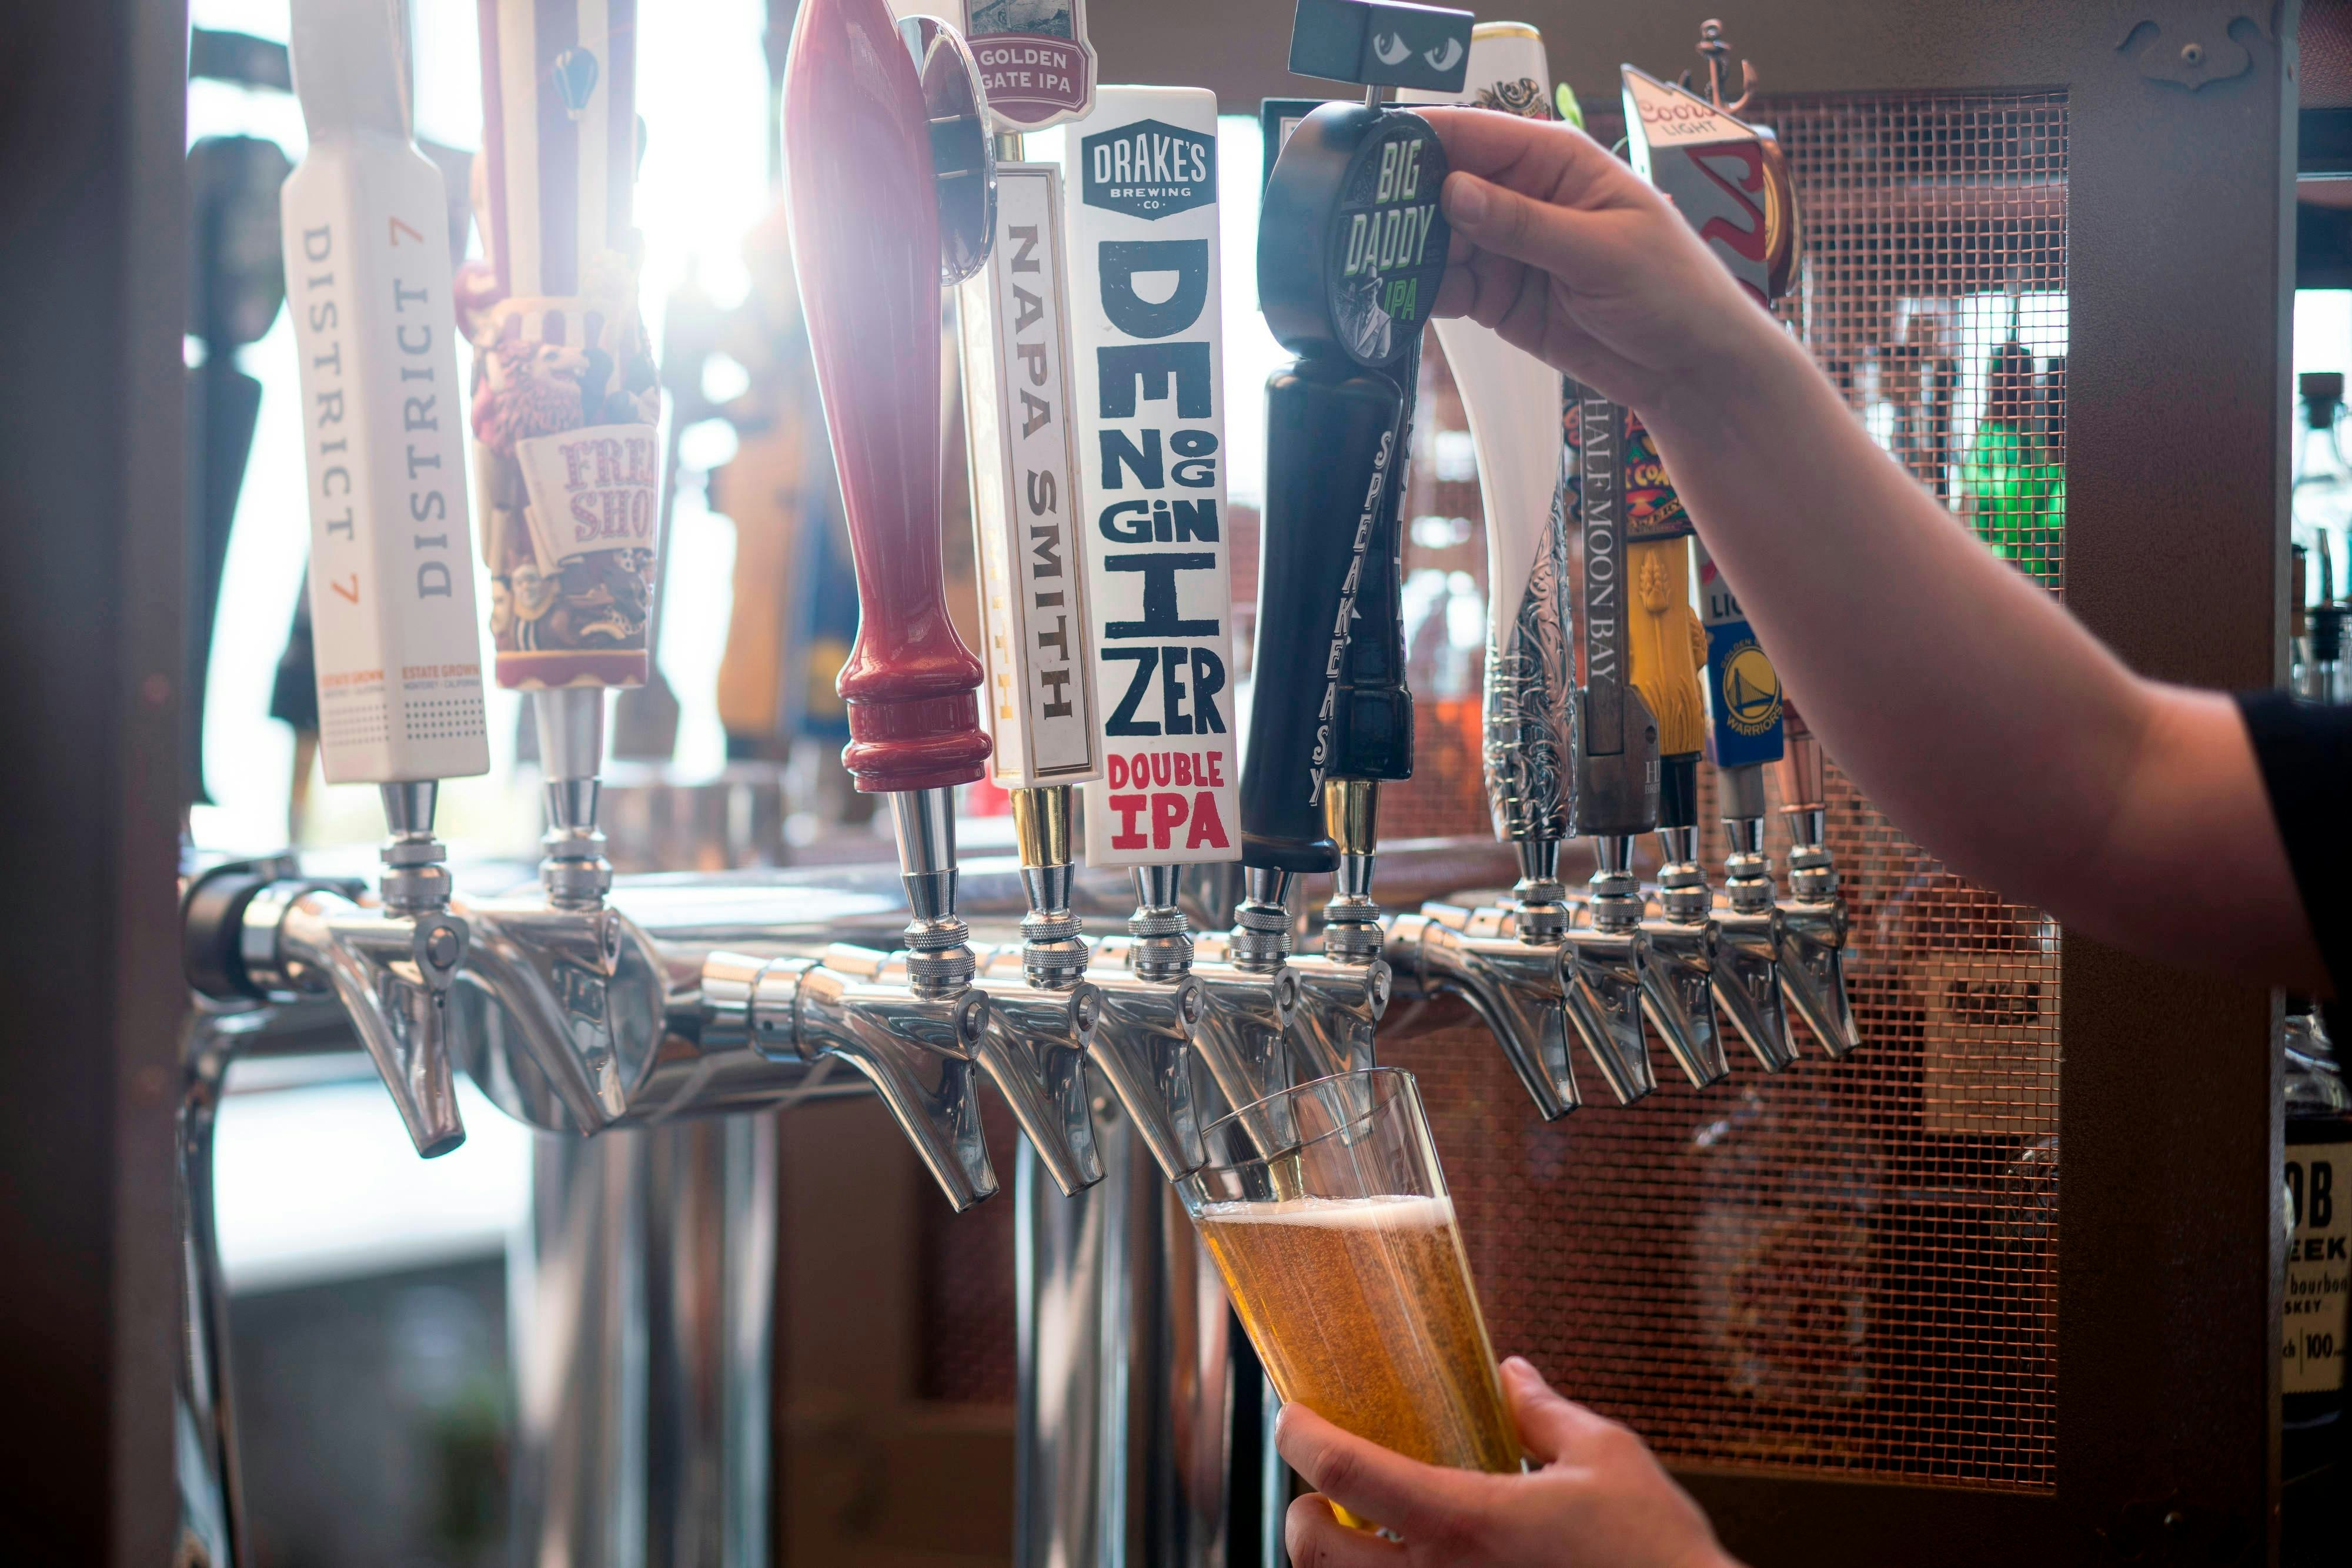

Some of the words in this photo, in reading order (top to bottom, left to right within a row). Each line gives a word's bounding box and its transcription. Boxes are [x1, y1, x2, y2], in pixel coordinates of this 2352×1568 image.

[980, 49, 1067, 69] GOLDEN
[981, 71, 1032, 90] GATE
[1038, 72, 1071, 93] IPA
[1637, 99, 1716, 123] Coors
[1662, 119, 1718, 136] LIGHT
[1093, 132, 1207, 184] DRAKE'S
[1375, 138, 1423, 205] BIG
[1110, 187, 1191, 199] BREWING
[1143, 200, 1160, 209] CO
[389, 216, 425, 248] 7
[1344, 205, 1435, 277] DADDY
[1384, 278, 1418, 321] IPA
[1008, 223, 1052, 440] NAPA
[304, 224, 354, 541] DISTRICT
[331, 574, 360, 606] 7
[394, 279, 452, 599] DISTRICT
[1584, 399, 1612, 492] HALF
[1634, 463, 1671, 487] COA
[570, 490, 654, 543] SHO
[1587, 499, 1614, 609] MOON
[1027, 469, 1073, 720] SMITH
[1309, 430, 1392, 807] SPEAKEASY
[1589, 617, 1616, 687] BAY
[1726, 704, 1783, 737] WARRIORS
[1107, 751, 1225, 790] DOUBLE
[1108, 791, 1231, 850] IPA
[2290, 1271, 2348, 1295] bourbon
[2306, 1332, 2334, 1360] 100
